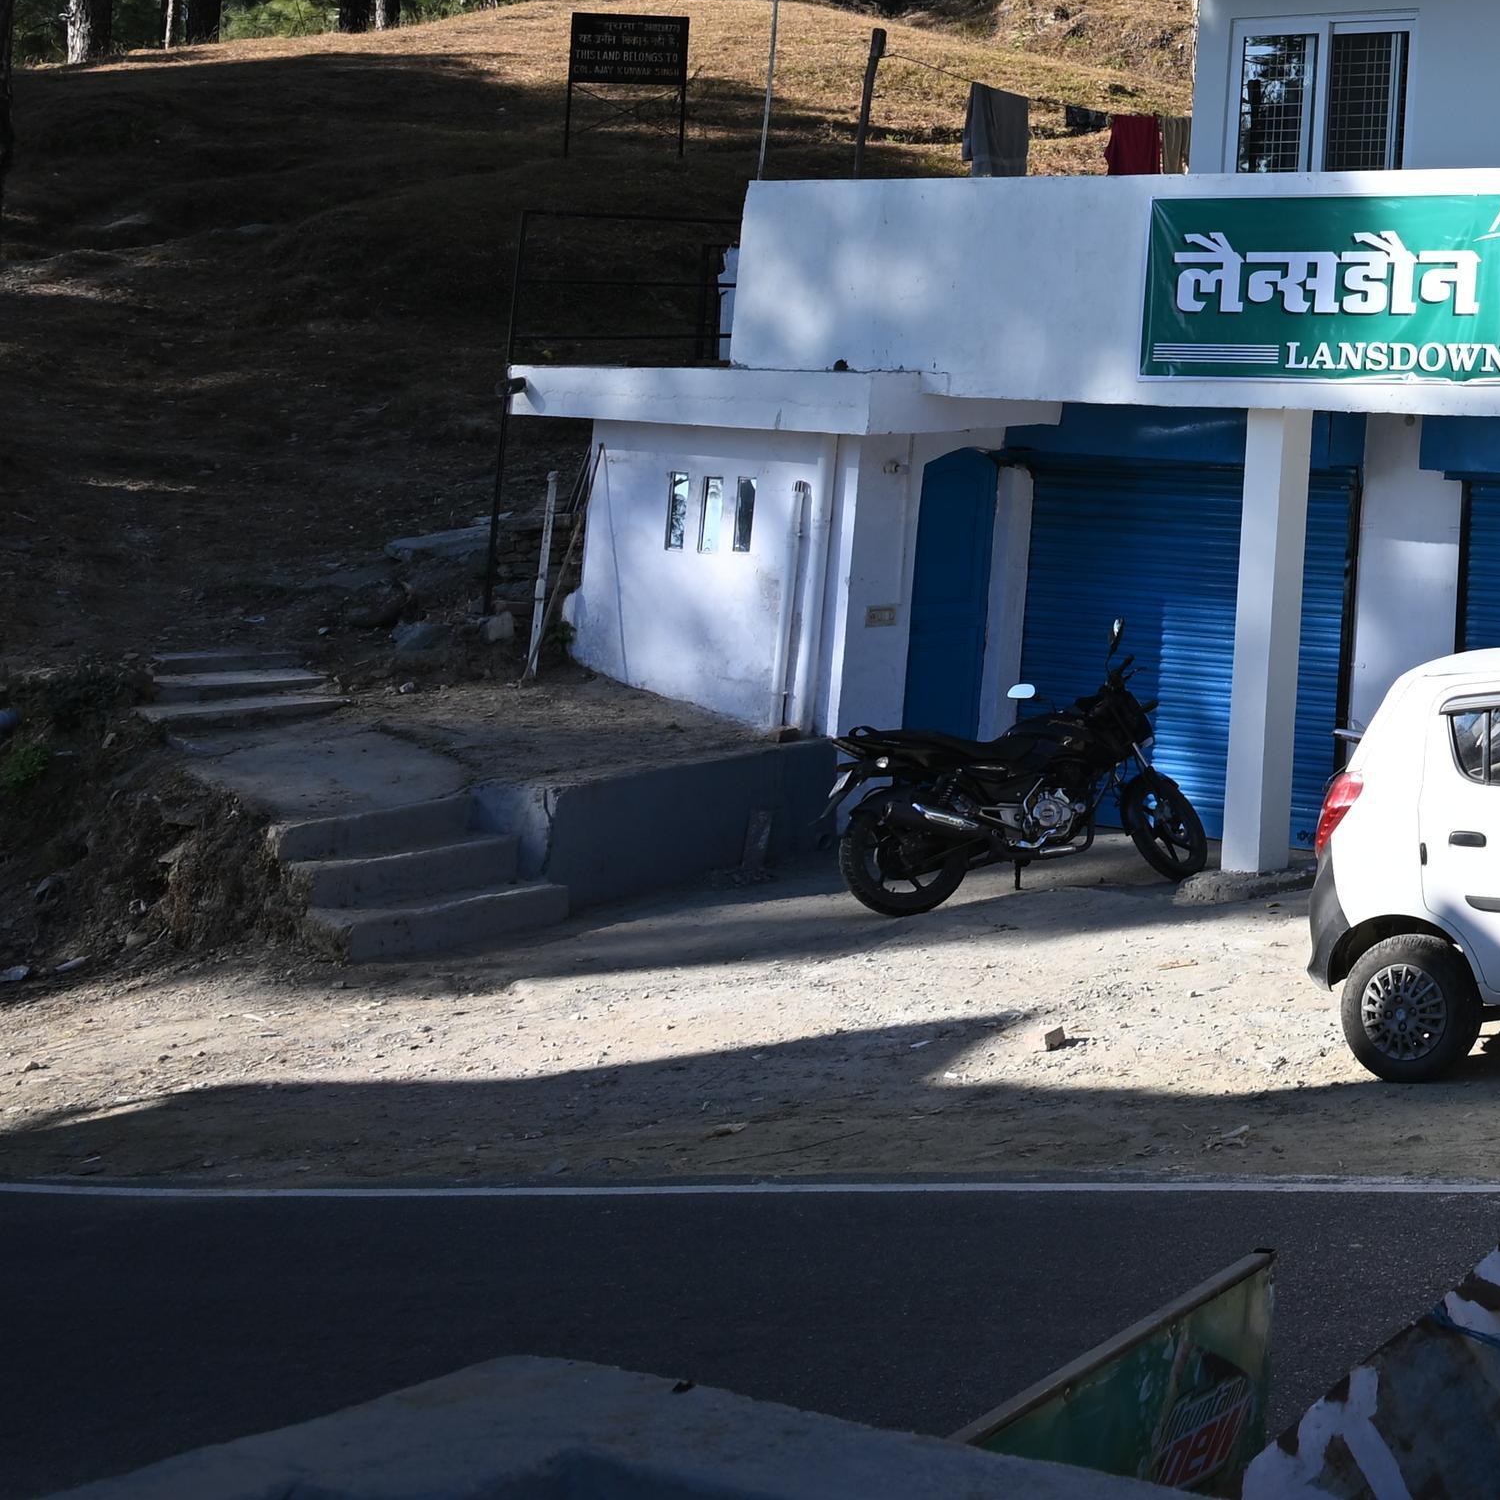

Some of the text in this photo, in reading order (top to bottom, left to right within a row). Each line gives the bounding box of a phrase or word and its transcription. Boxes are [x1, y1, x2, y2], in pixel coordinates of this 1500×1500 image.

[576, 49, 678, 63] THIS LAND BELONGS TO
[1174, 231, 1482, 315] लैन्सडौन
